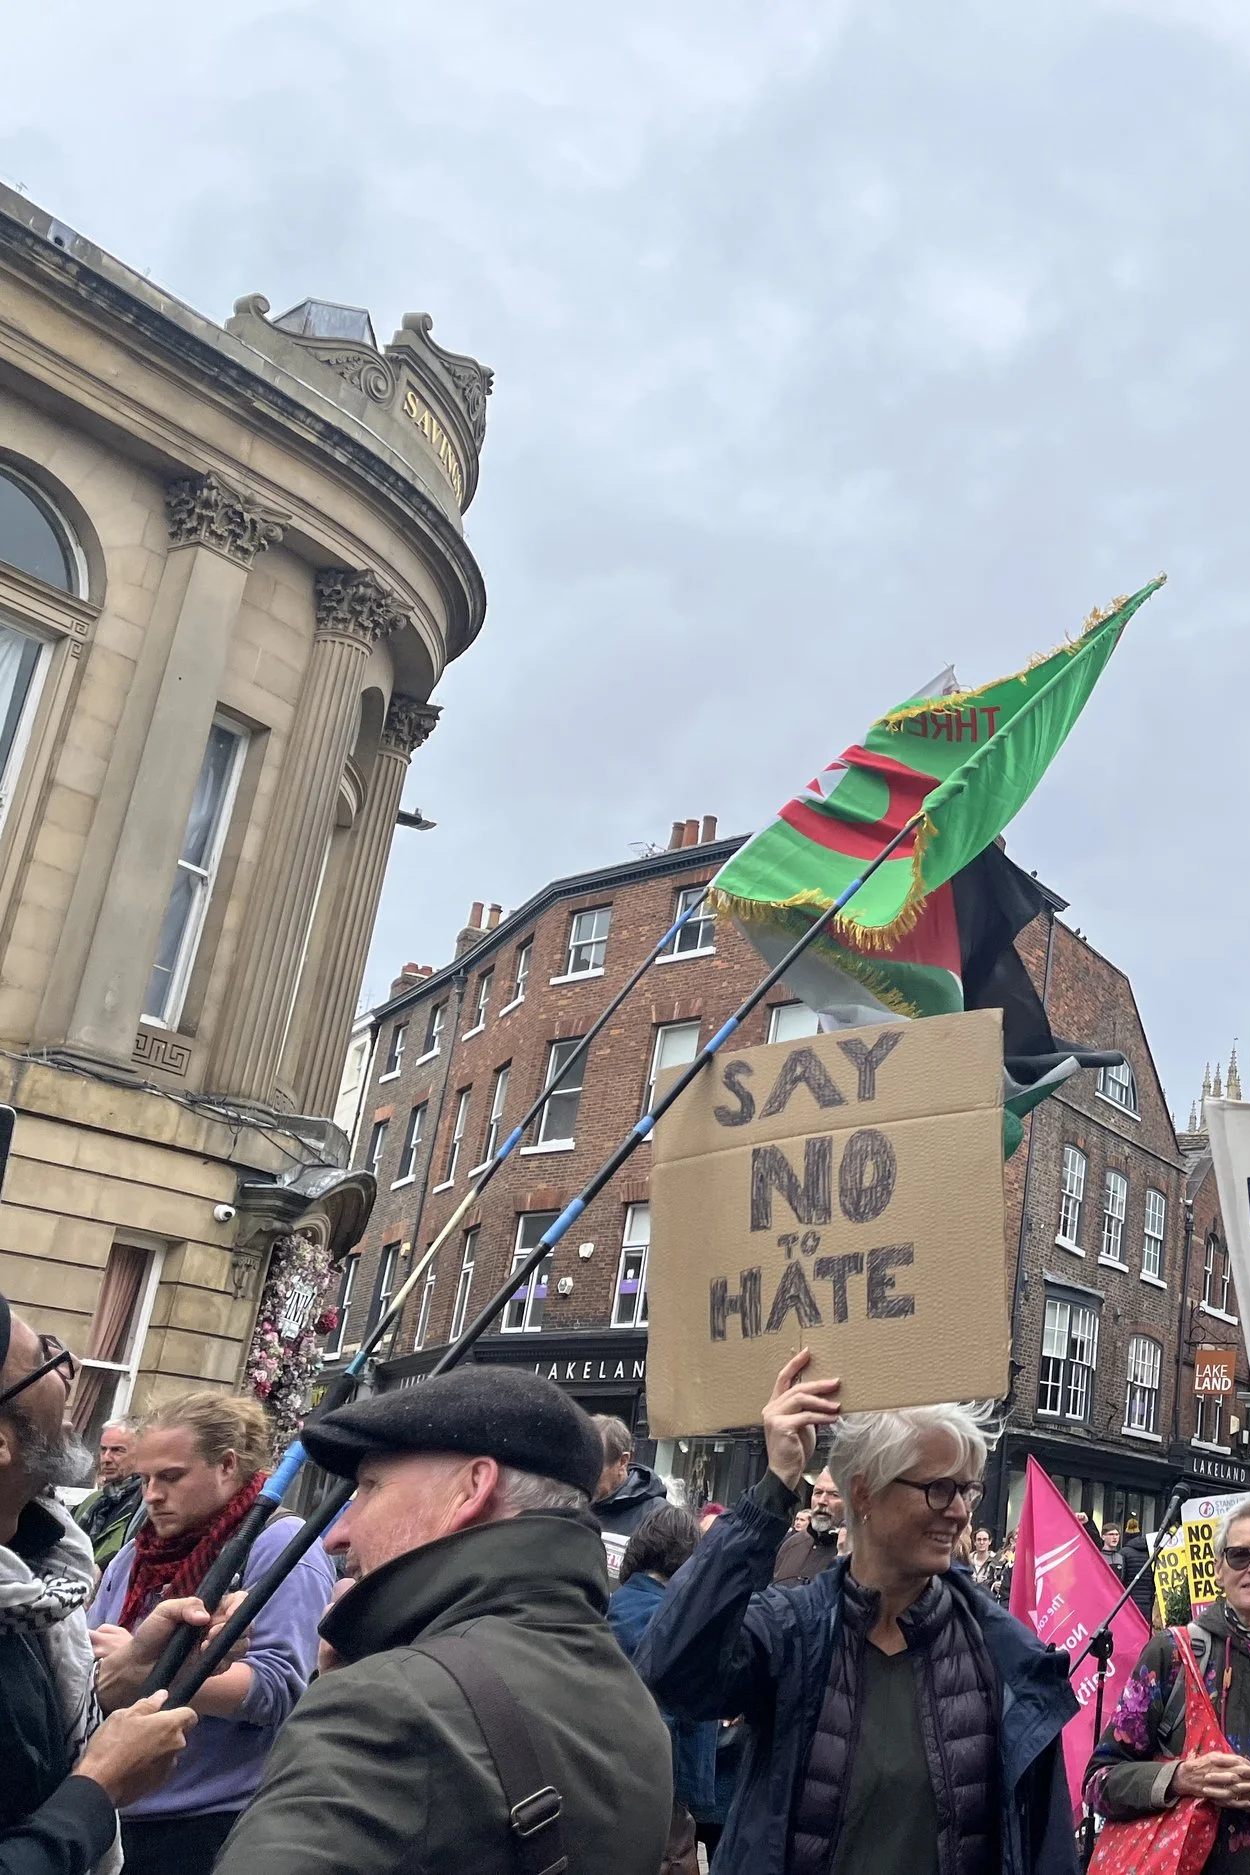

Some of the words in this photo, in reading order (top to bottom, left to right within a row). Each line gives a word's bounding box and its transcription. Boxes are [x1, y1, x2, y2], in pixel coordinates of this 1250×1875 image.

[713, 1031, 904, 1127] SAY
[750, 1128, 896, 1232] NO
[777, 1230, 820, 1259] TO
[709, 1242, 915, 1342] HATE
[1196, 1364, 1228, 1378] LAKE
[1195, 1377, 1231, 1391] LAND
[1193, 1458, 1246, 1482] LAKELAND
[1188, 1524, 1212, 1542] NO
[1157, 1553, 1178, 1570] NO
[1192, 1561, 1215, 1579] NO
